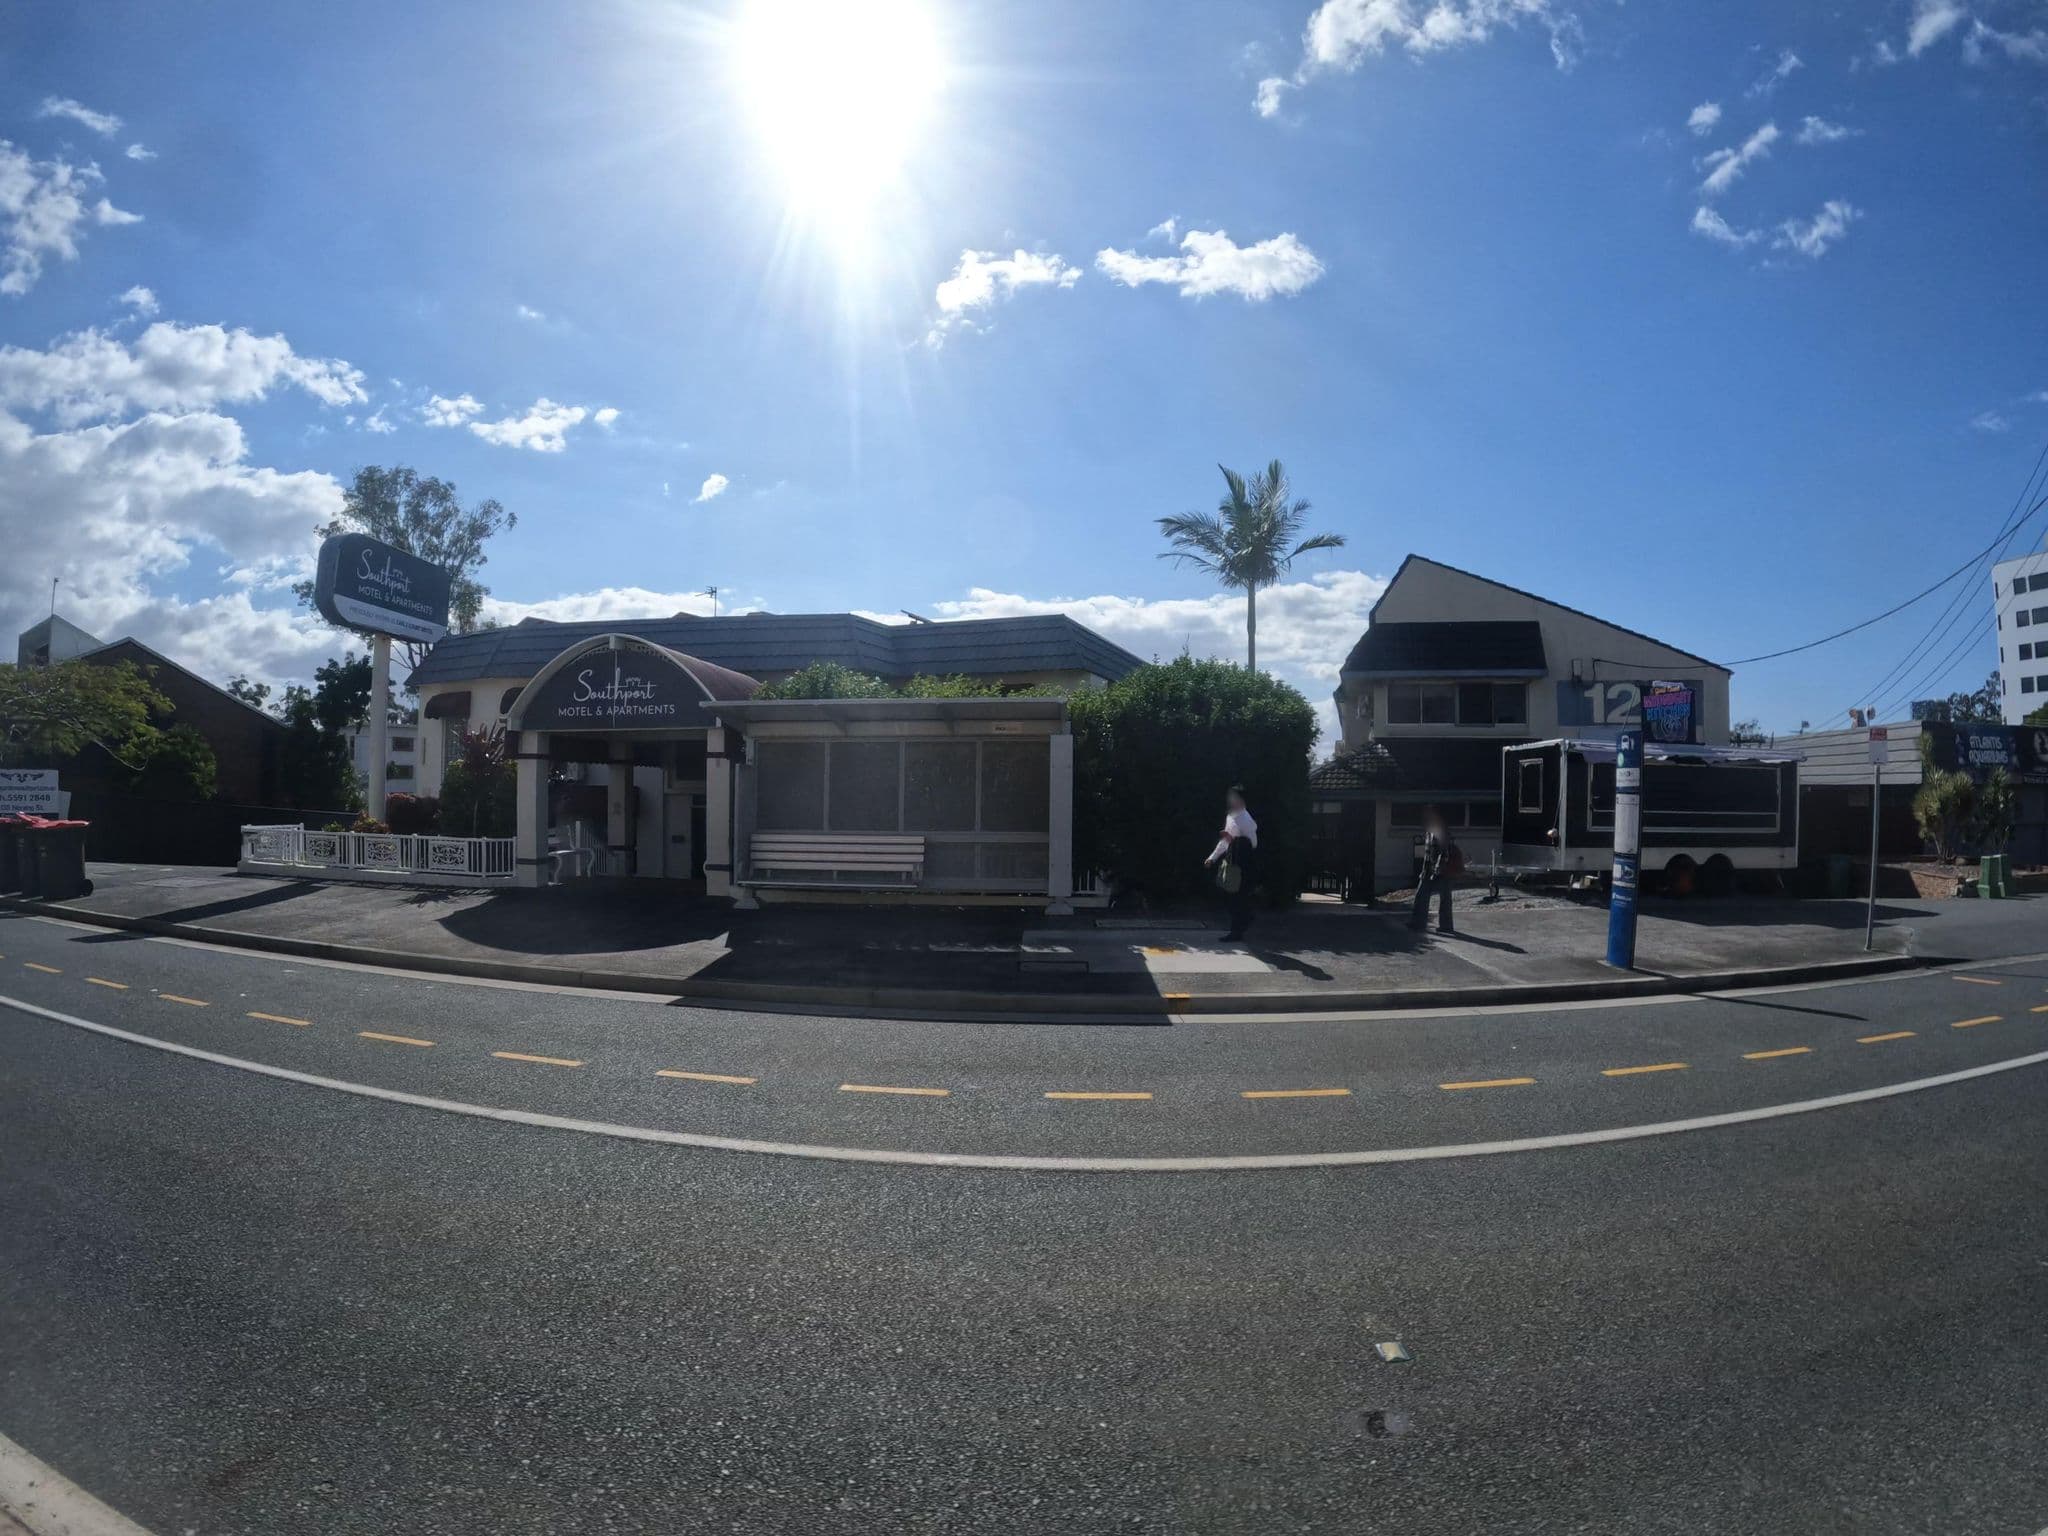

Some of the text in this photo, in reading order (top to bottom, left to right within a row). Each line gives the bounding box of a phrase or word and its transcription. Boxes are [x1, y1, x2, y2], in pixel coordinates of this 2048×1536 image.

[356, 548, 413, 595] Southport
[358, 585, 382, 601] MOTEL
[391, 596, 433, 616] APARTMENTS
[573, 667, 657, 707] Southport
[558, 704, 676, 717] MOTEL & APARTMENTS
[1969, 735, 2003, 749] ATLANTIS
[1968, 750, 2009, 766] AQUARIUMS
